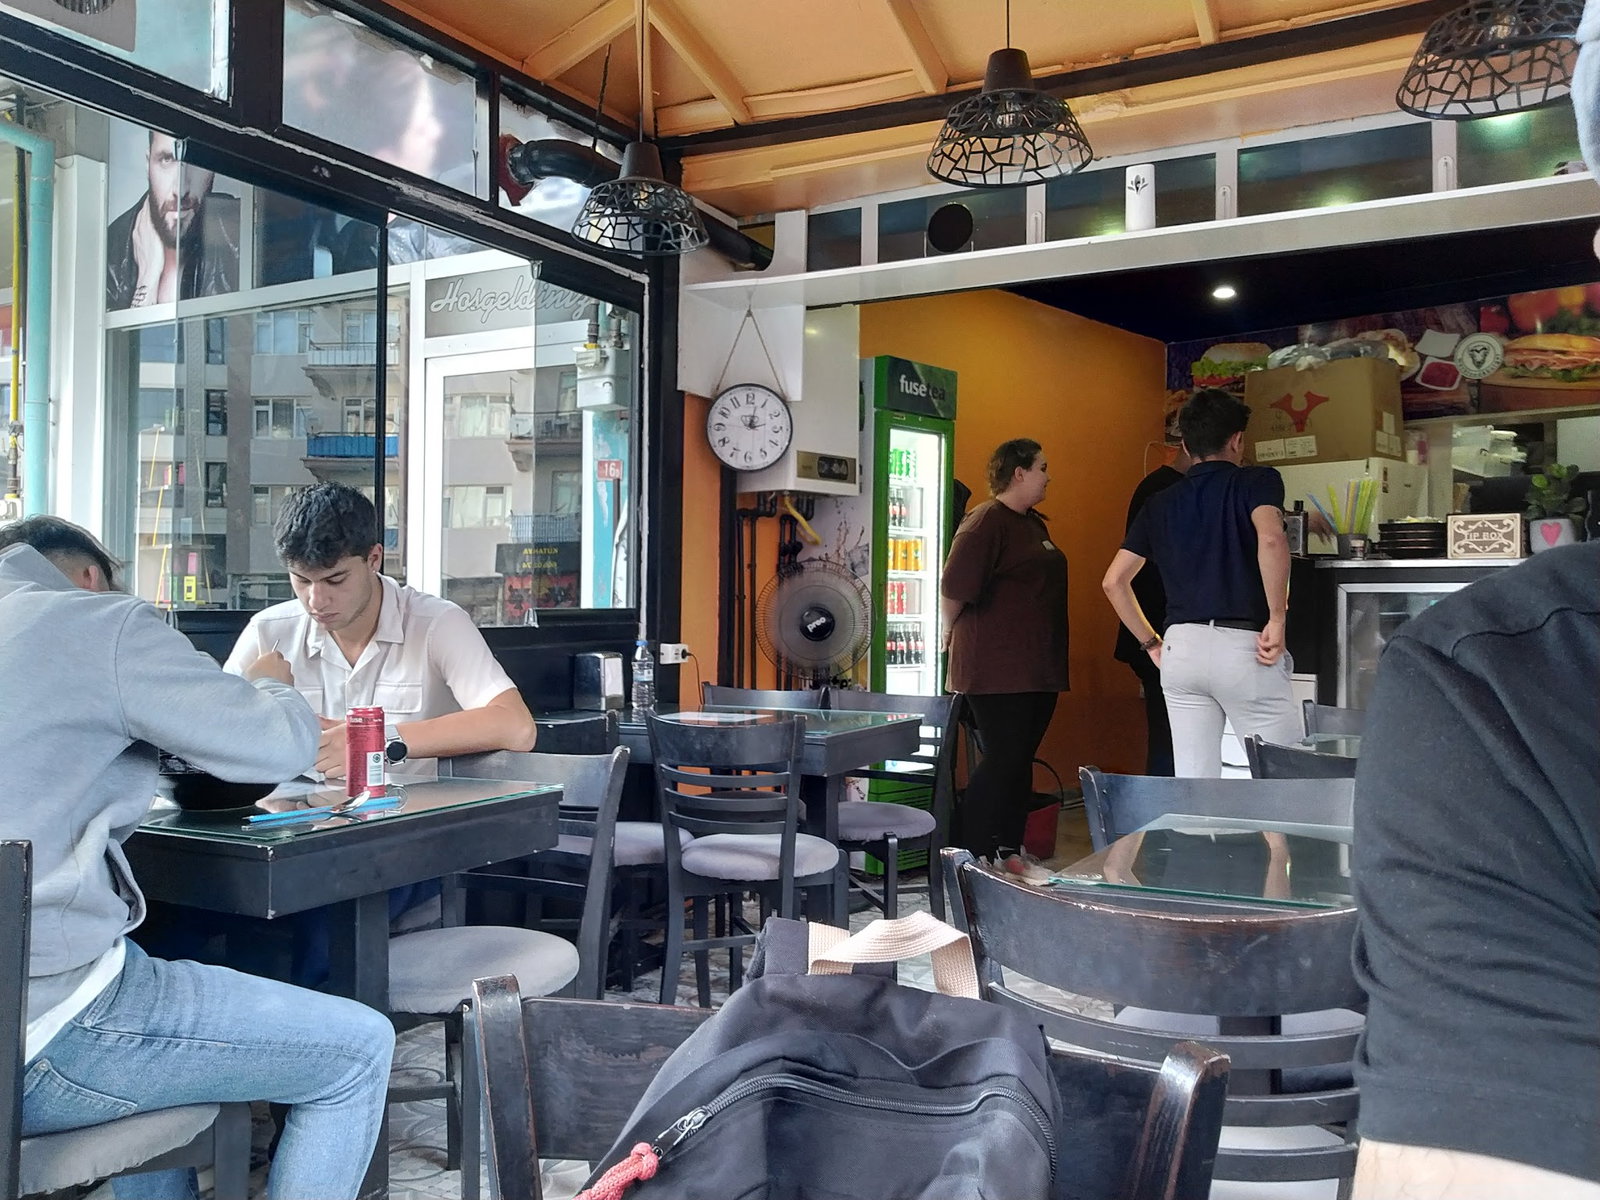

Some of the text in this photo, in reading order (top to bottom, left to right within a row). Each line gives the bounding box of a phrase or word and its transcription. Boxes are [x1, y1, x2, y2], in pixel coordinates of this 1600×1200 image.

[745, 392, 755, 405] 12
[1464, 531, 1503, 540] TIP BOX
[807, 616, 826, 633] preo
